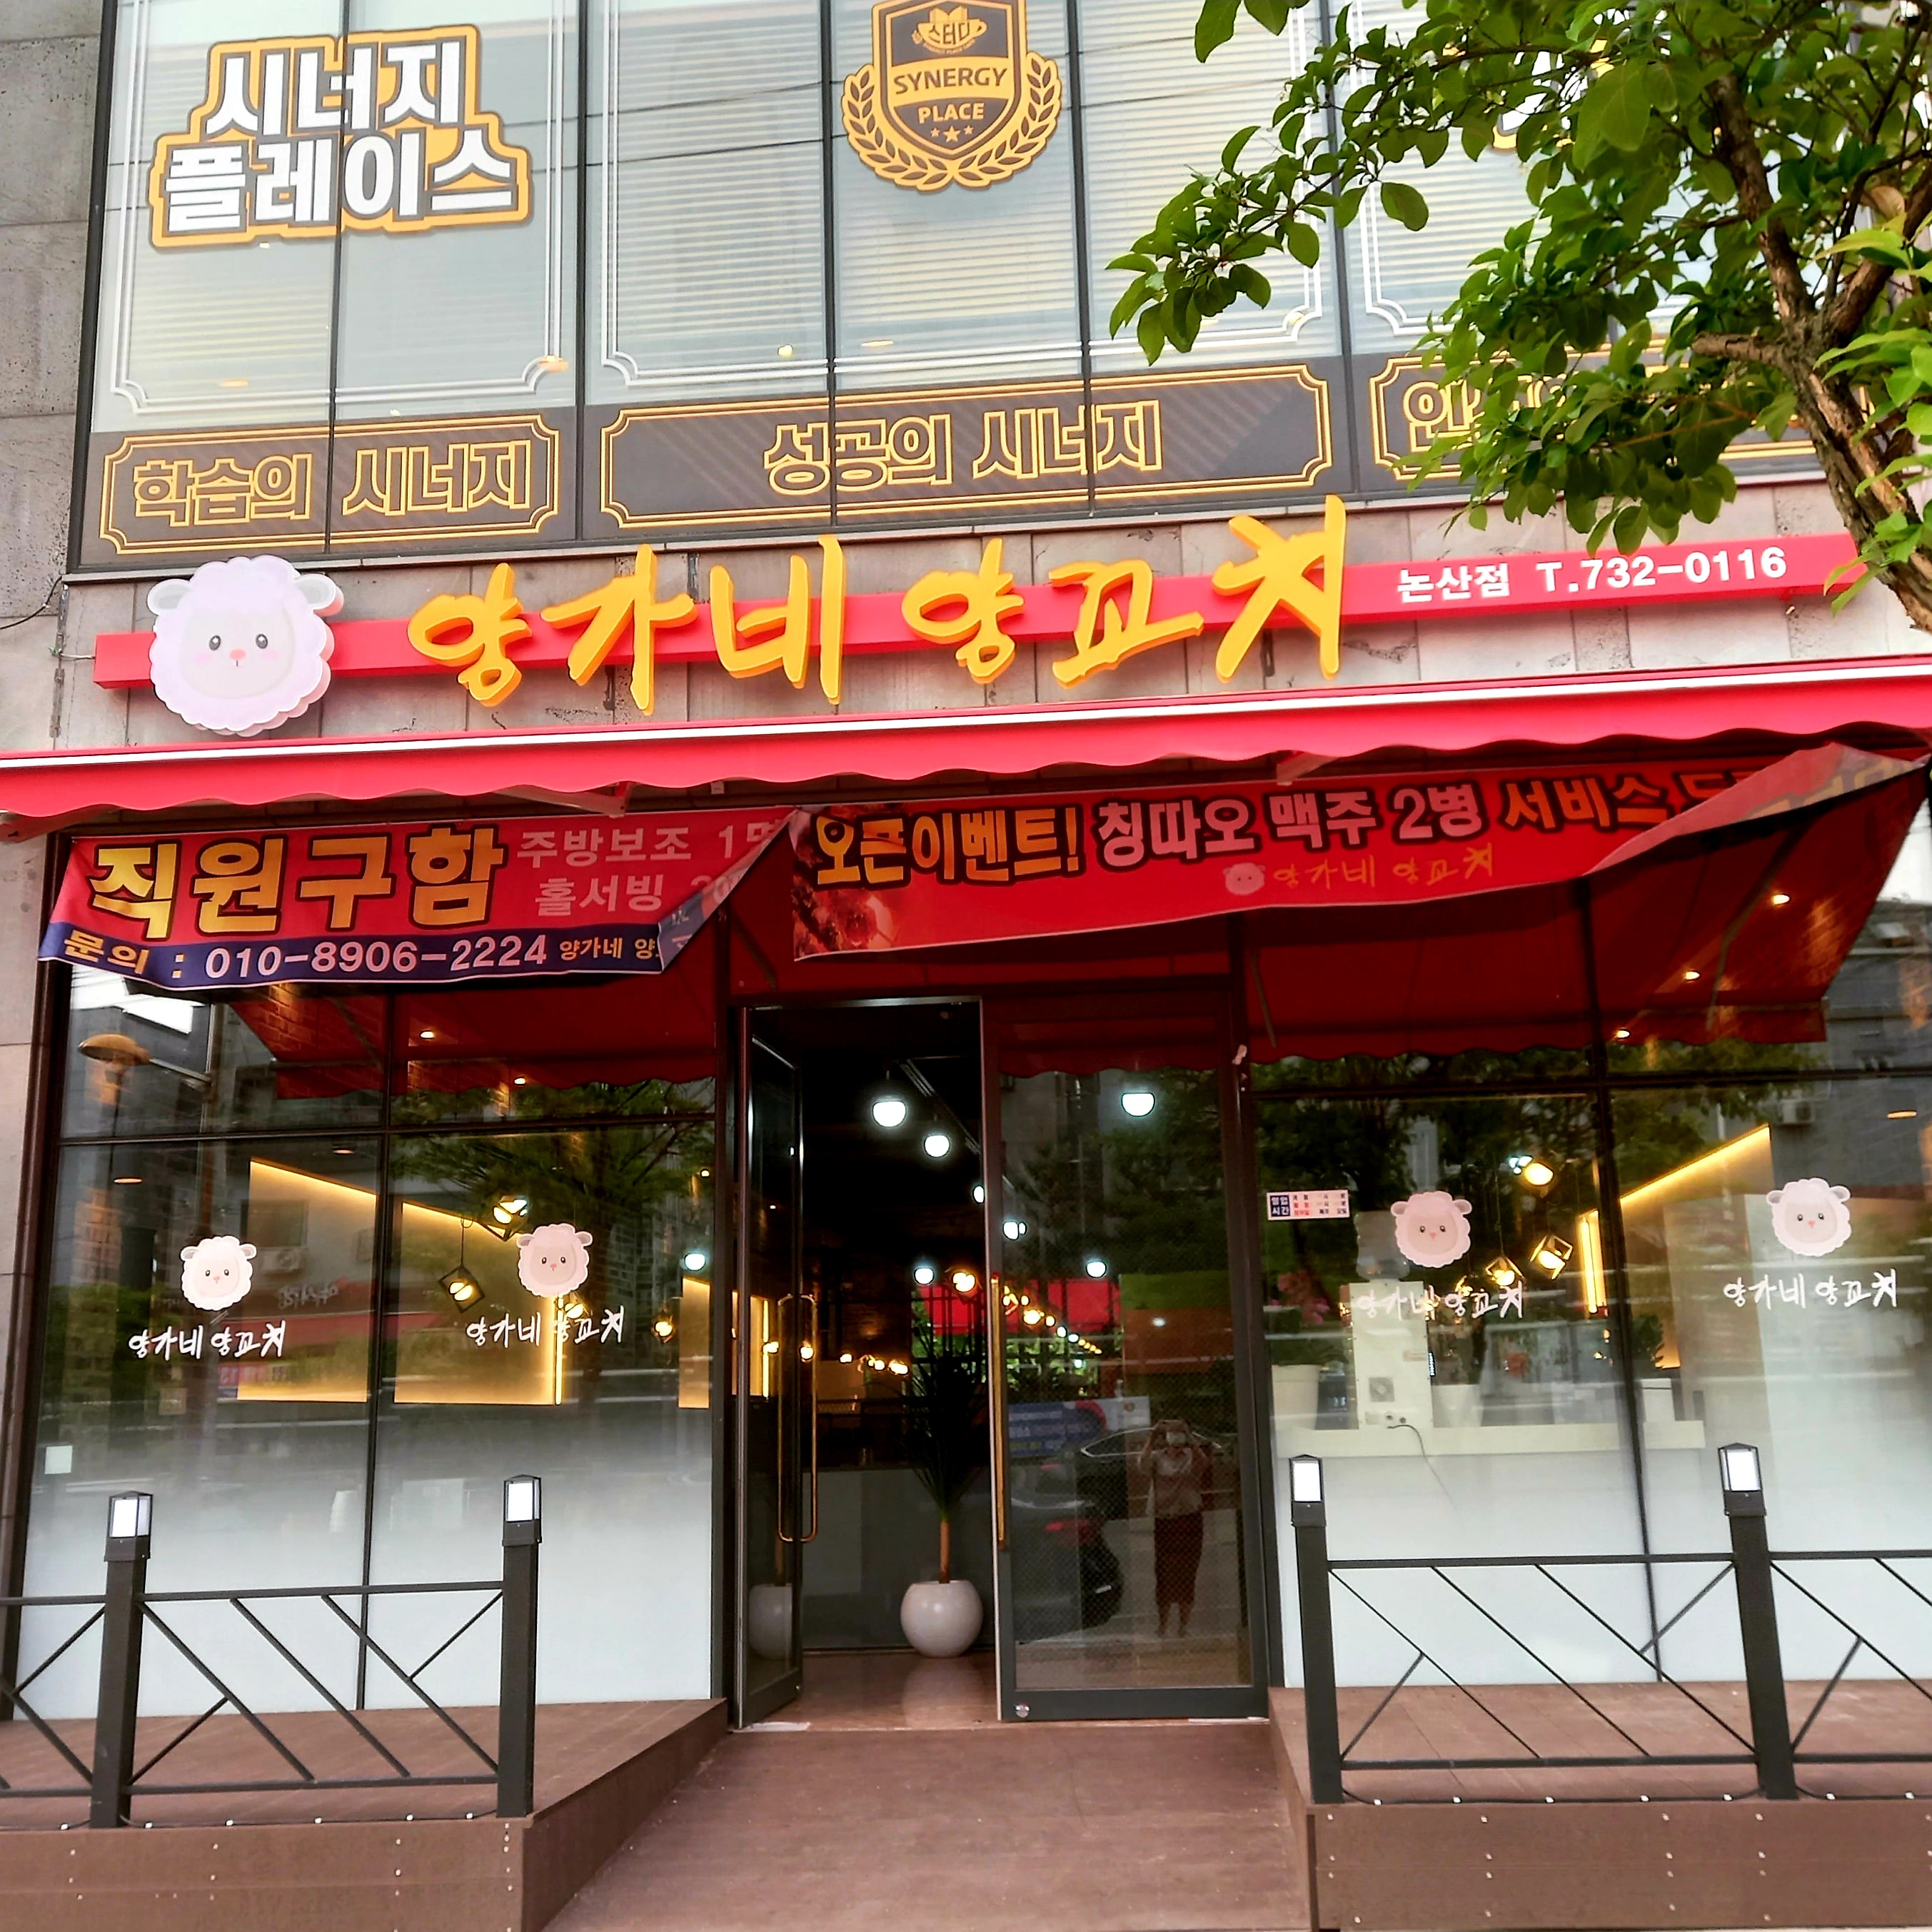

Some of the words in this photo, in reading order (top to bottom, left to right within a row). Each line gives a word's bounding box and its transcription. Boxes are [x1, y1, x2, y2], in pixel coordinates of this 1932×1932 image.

[206, 41, 461, 136] 시너지
[893, 67, 1007, 94] SYNERGY
[917, 103, 985, 124] PLACE
[165, 129, 514, 232] 플레이스
[765, 413, 952, 496] 성공의
[973, 400, 1162, 479] 시너지
[133, 453, 312, 526] 학습의
[343, 441, 530, 516] 시너지
[1397, 563, 1510, 604] 논산점
[1536, 546, 1788, 593] T.732-0116
[407, 534, 846, 715] 양가네
[901, 494, 1347, 689] 양꼬치
[516, 827, 692, 869] 주방보조
[816, 807, 1081, 885] 오픈이벤트!
[1096, 795, 1254, 869] 칭따오
[1271, 790, 1377, 850] 맥주
[1392, 783, 1484, 840] 2병
[1503, 776, 1669, 830] 서비스
[90, 825, 505, 939] 직원구함
[1273, 855, 1375, 890] 양가네
[1392, 841, 1493, 887] 양꼬치
[535, 874, 664, 916] 홀서빙
[64, 930, 149, 975] 문의
[205, 934, 545, 981] 010-8906-2224
[560, 937, 623, 960] 양가네
[1357, 1285, 1435, 1320] 양가네
[1724, 1273, 1806, 1309] 양가네
[1816, 1268, 1896, 1307] 양꼬치
[129, 1325, 203, 1361] 양가네
[211, 1319, 286, 1357] 양꼬치
[467, 1312, 540, 1348] 양가네
